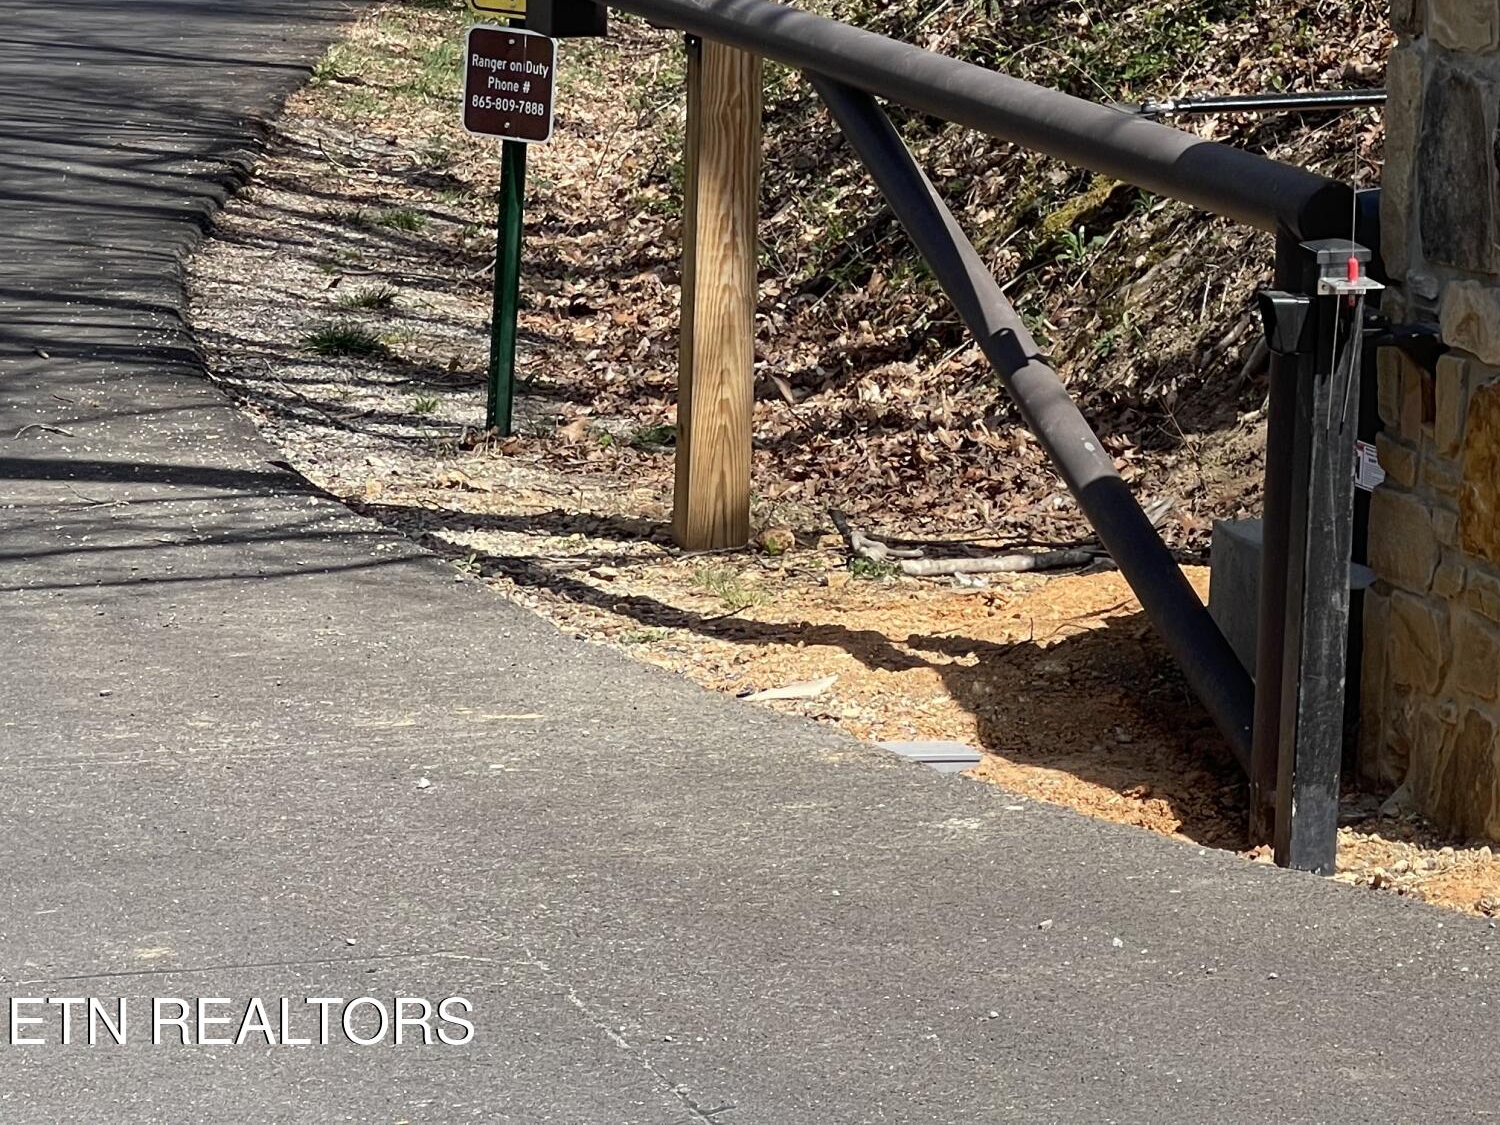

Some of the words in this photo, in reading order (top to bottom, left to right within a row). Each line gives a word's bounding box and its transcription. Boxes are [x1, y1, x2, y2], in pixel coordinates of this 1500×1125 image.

[472, 53, 507, 73] Ranger
[510, 61, 523, 73] on
[525, 60, 549, 79] Duty
[487, 76, 520, 93] Phone
[522, 81, 531, 94] #
[471, 94, 545, 117] 865-809-7888
